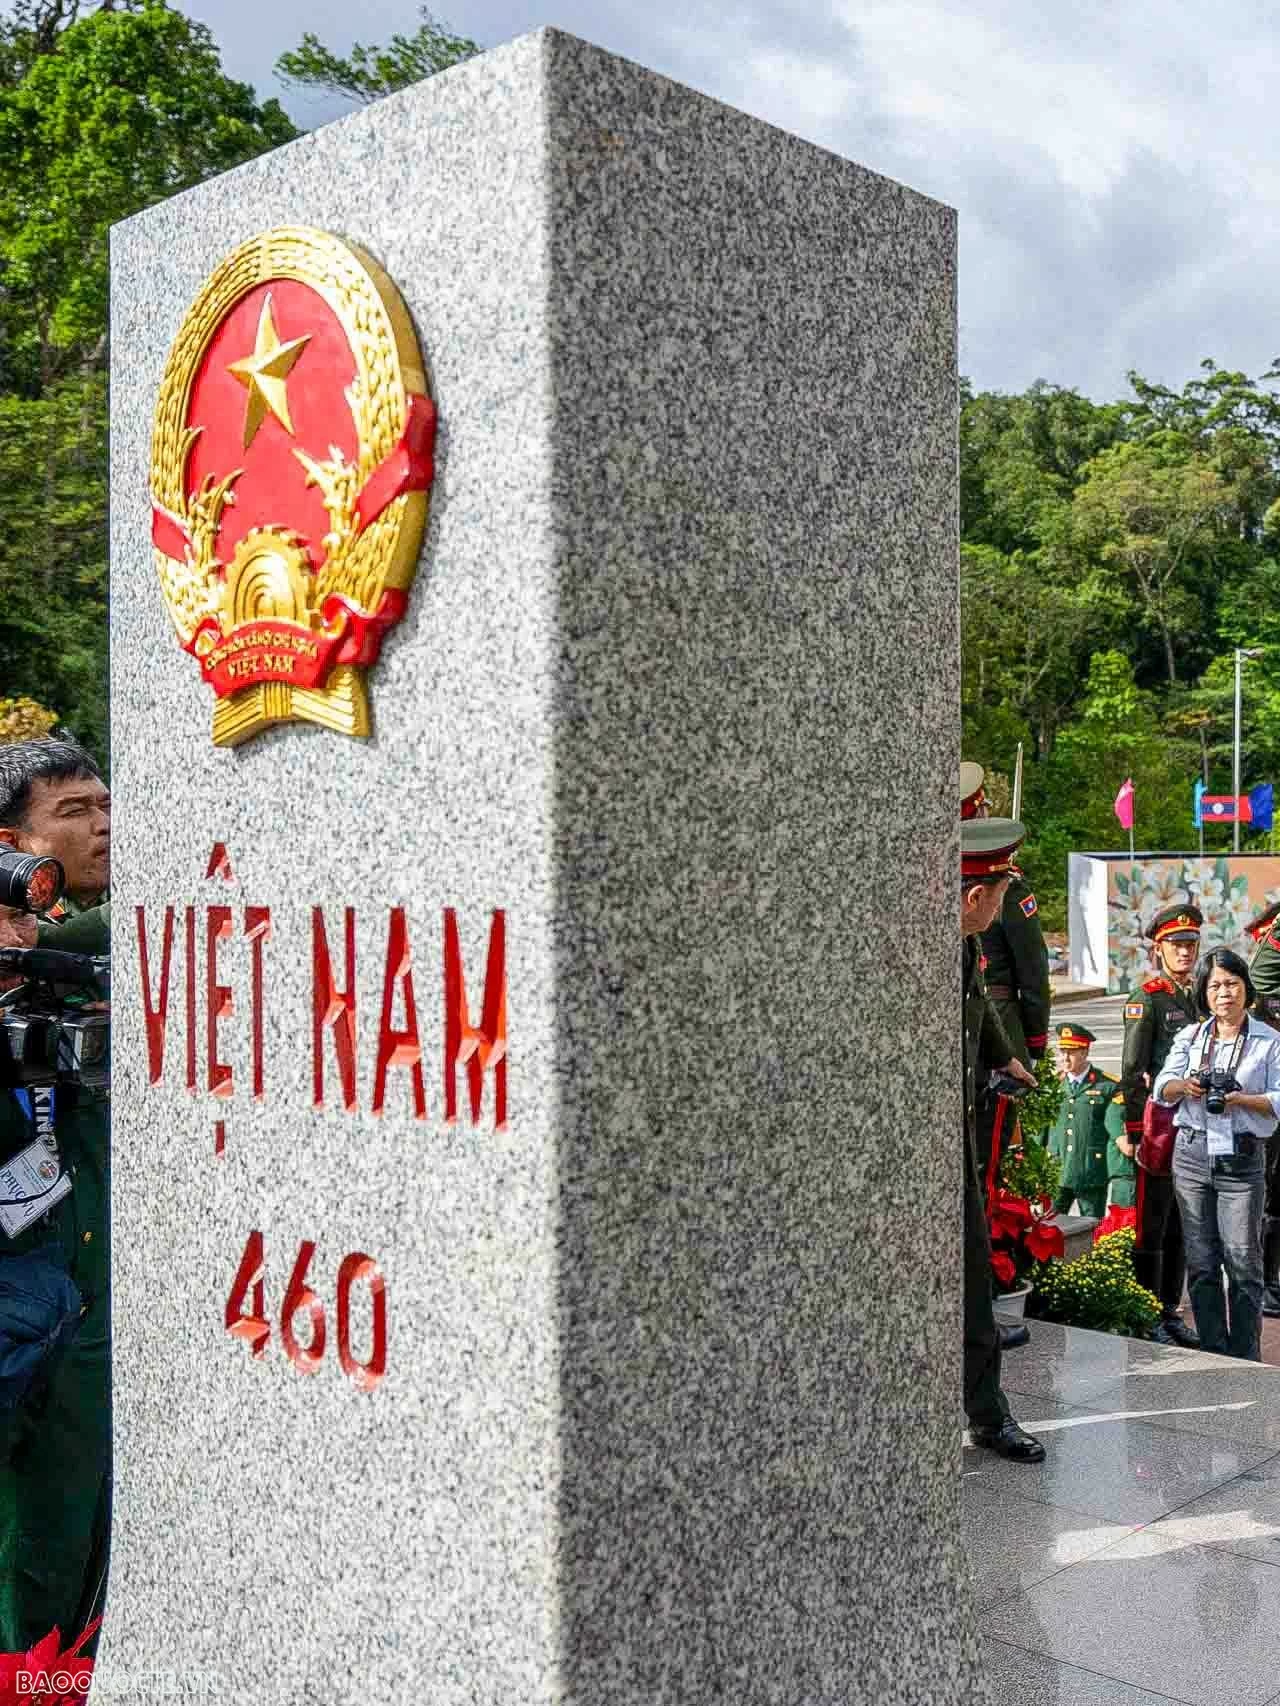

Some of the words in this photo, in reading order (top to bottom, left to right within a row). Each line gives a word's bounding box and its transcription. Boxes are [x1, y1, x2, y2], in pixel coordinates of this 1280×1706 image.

[136, 842, 270, 1160] VIỆT
[312, 907, 508, 1132] NAM
[225, 1231, 389, 1393] 460
